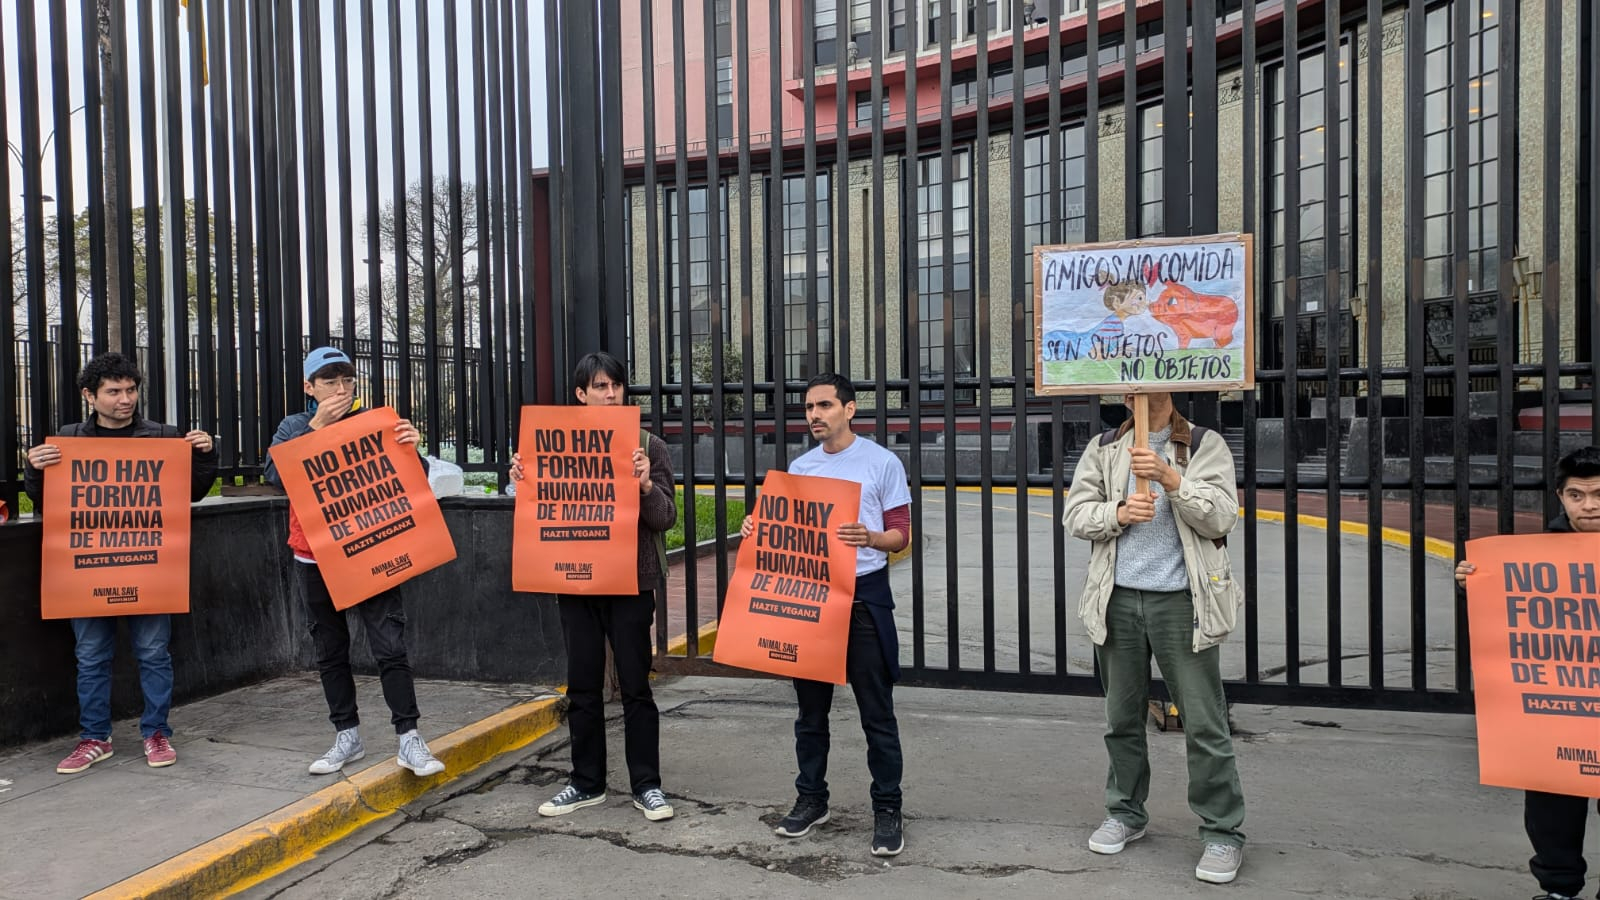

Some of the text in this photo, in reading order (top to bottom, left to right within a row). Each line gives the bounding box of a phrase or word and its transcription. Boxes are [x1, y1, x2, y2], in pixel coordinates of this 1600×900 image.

[1126, 253, 1153, 286] NO
[1043, 331, 1168, 361] SON SUJETOS
[1121, 354, 1231, 382] NO OBJETOS
[535, 429, 615, 454] NO HAY
[302, 430, 385, 482] NO HAY
[537, 456, 615, 480] FORMA
[71, 459, 164, 483] NO HAY
[311, 454, 397, 505] FORMA
[71, 485, 162, 508] FORMA
[321, 477, 405, 524] HUMANA
[537, 482, 616, 503] HUMANA
[70, 510, 163, 529] HUMANA
[329, 496, 413, 542] DE MATAR
[537, 503, 615, 522] DE MATAR
[759, 494, 834, 529] NO HAY
[69, 530, 162, 549] DE MATAR
[346, 519, 413, 554] HAZTE VEGANX
[543, 529, 608, 538] HAZTE VEGANX
[756, 523, 830, 558] FORMA
[77, 553, 155, 566] HAZTE VEGANX
[371, 560, 396, 576] ANIMAL
[394, 553, 410, 566] SAVE
[554, 562, 592, 573] ANIMAL SAVE
[756, 550, 831, 583] HUMANA
[750, 573, 830, 604] DE MATAR
[1503, 562, 1600, 594] NO H
[93, 586, 138, 597] ANIMAL SAVE
[752, 601, 817, 619] HAZTE VEGANX
[758, 637, 799, 655] ANIMAL SAVE
[1510, 662, 1548, 685] DE
[1527, 698, 1577, 711] HAZTE
[1556, 746, 1600, 764] ANIMAL
